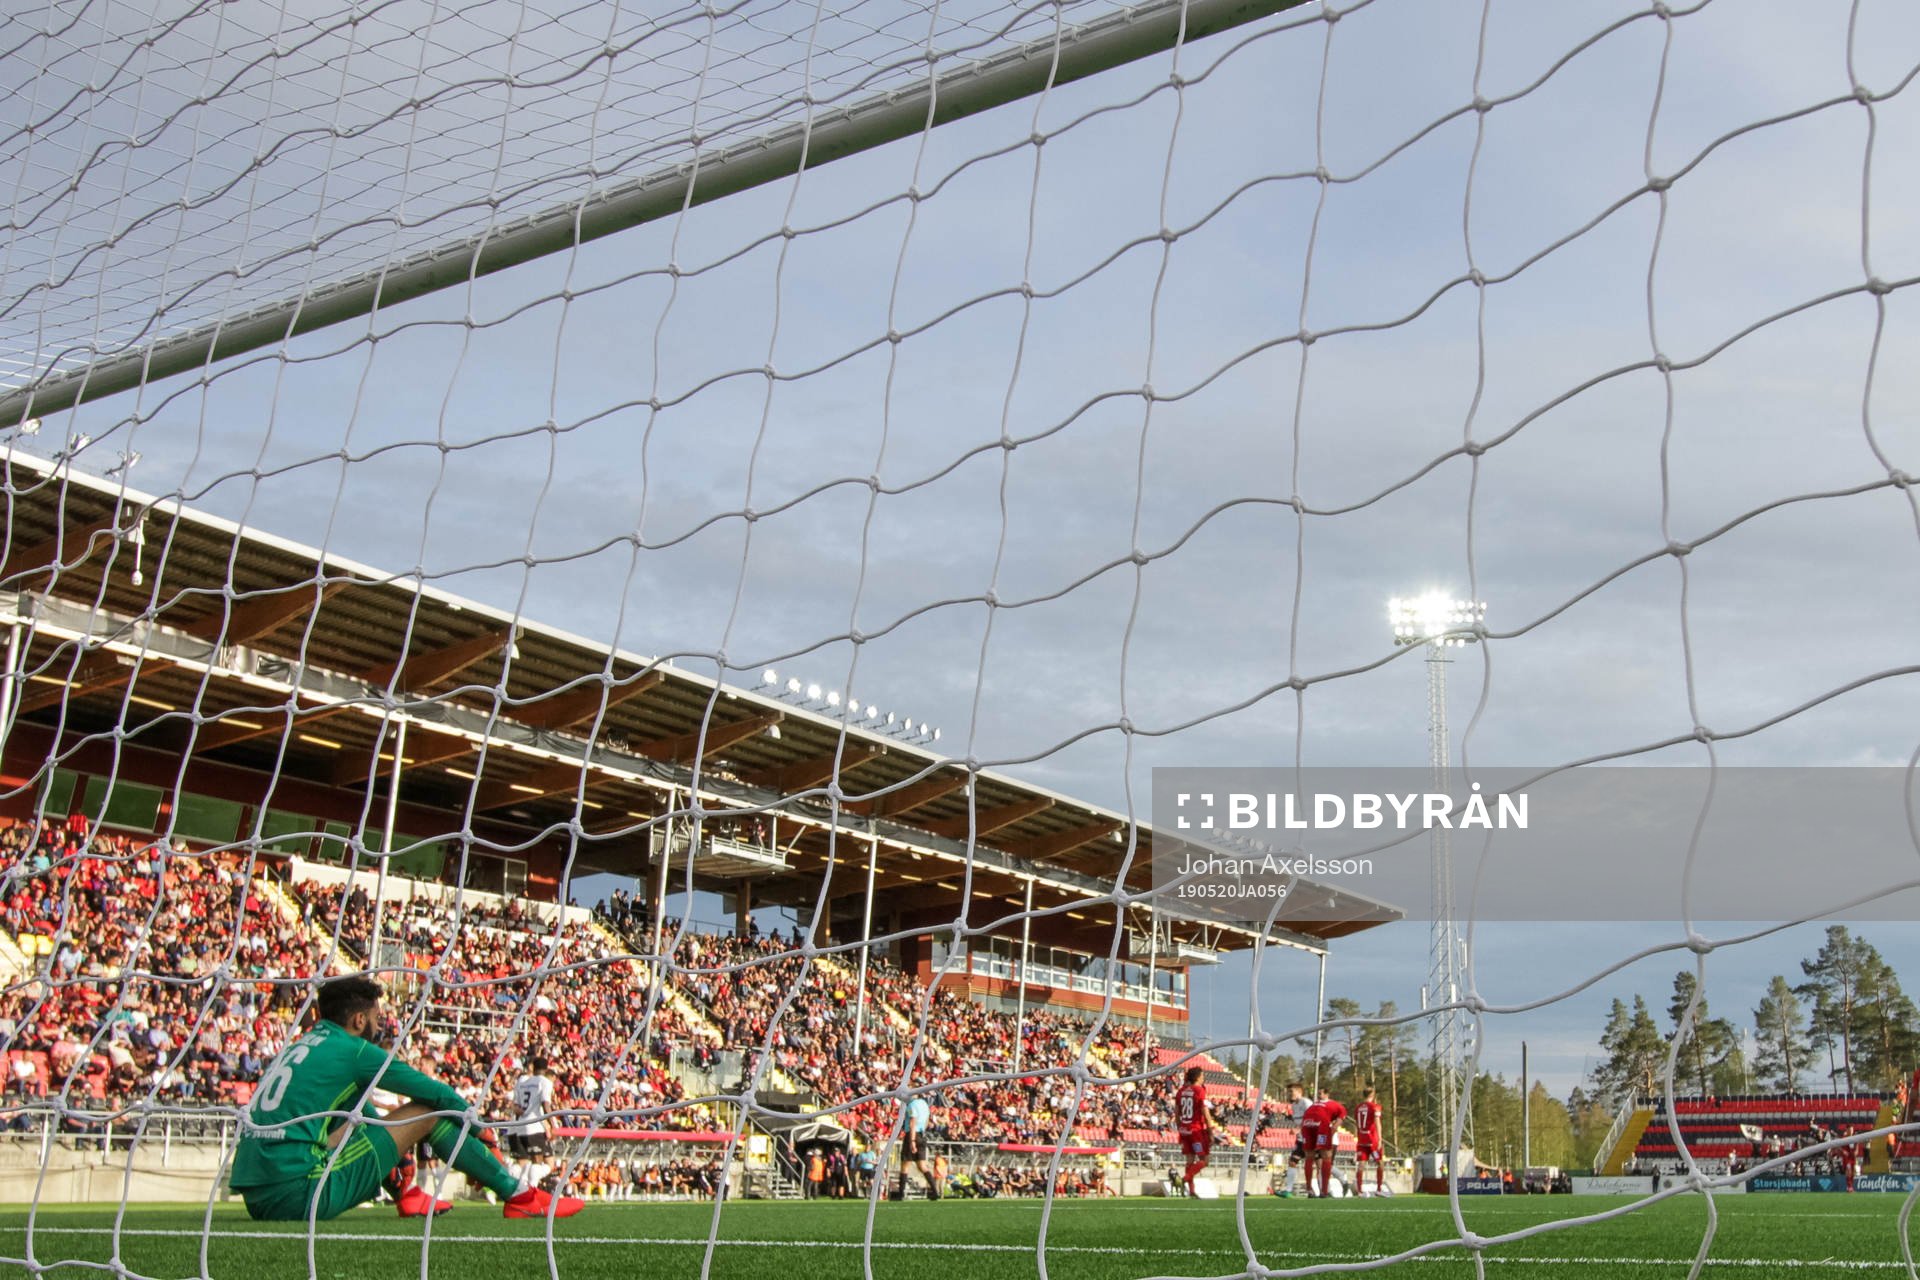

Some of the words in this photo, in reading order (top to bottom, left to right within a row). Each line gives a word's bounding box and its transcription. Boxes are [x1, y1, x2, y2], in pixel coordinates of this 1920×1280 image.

[1181, 1096, 1194, 1118] 28
[1357, 1111, 1368, 1129] 17
[1753, 1178, 1811, 1190] Storsjöbadet
[1854, 1175, 1900, 1192] Tandfén
